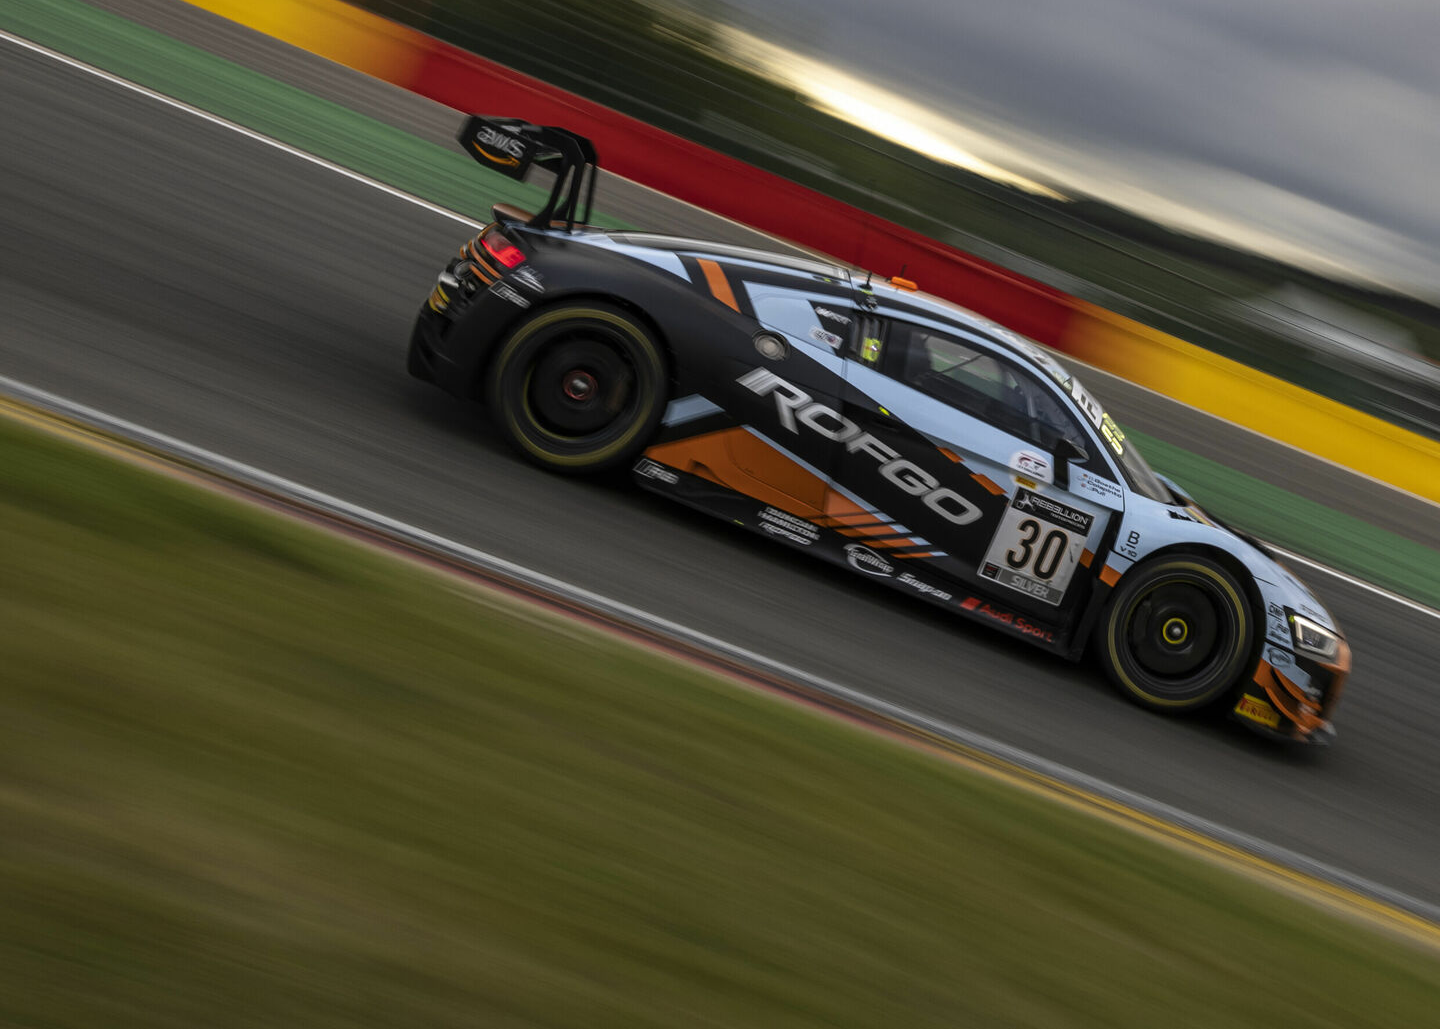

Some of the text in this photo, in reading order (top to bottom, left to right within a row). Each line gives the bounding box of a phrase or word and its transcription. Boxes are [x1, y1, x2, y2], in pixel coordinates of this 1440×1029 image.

[735, 366, 983, 524] ROFGO
[1031, 495, 1089, 525] REBELLION
[1006, 519, 1068, 580] 30
[1127, 530, 1141, 544] B
[1011, 576, 1051, 599] SILVER
[980, 604, 1055, 644] Audi Sport
